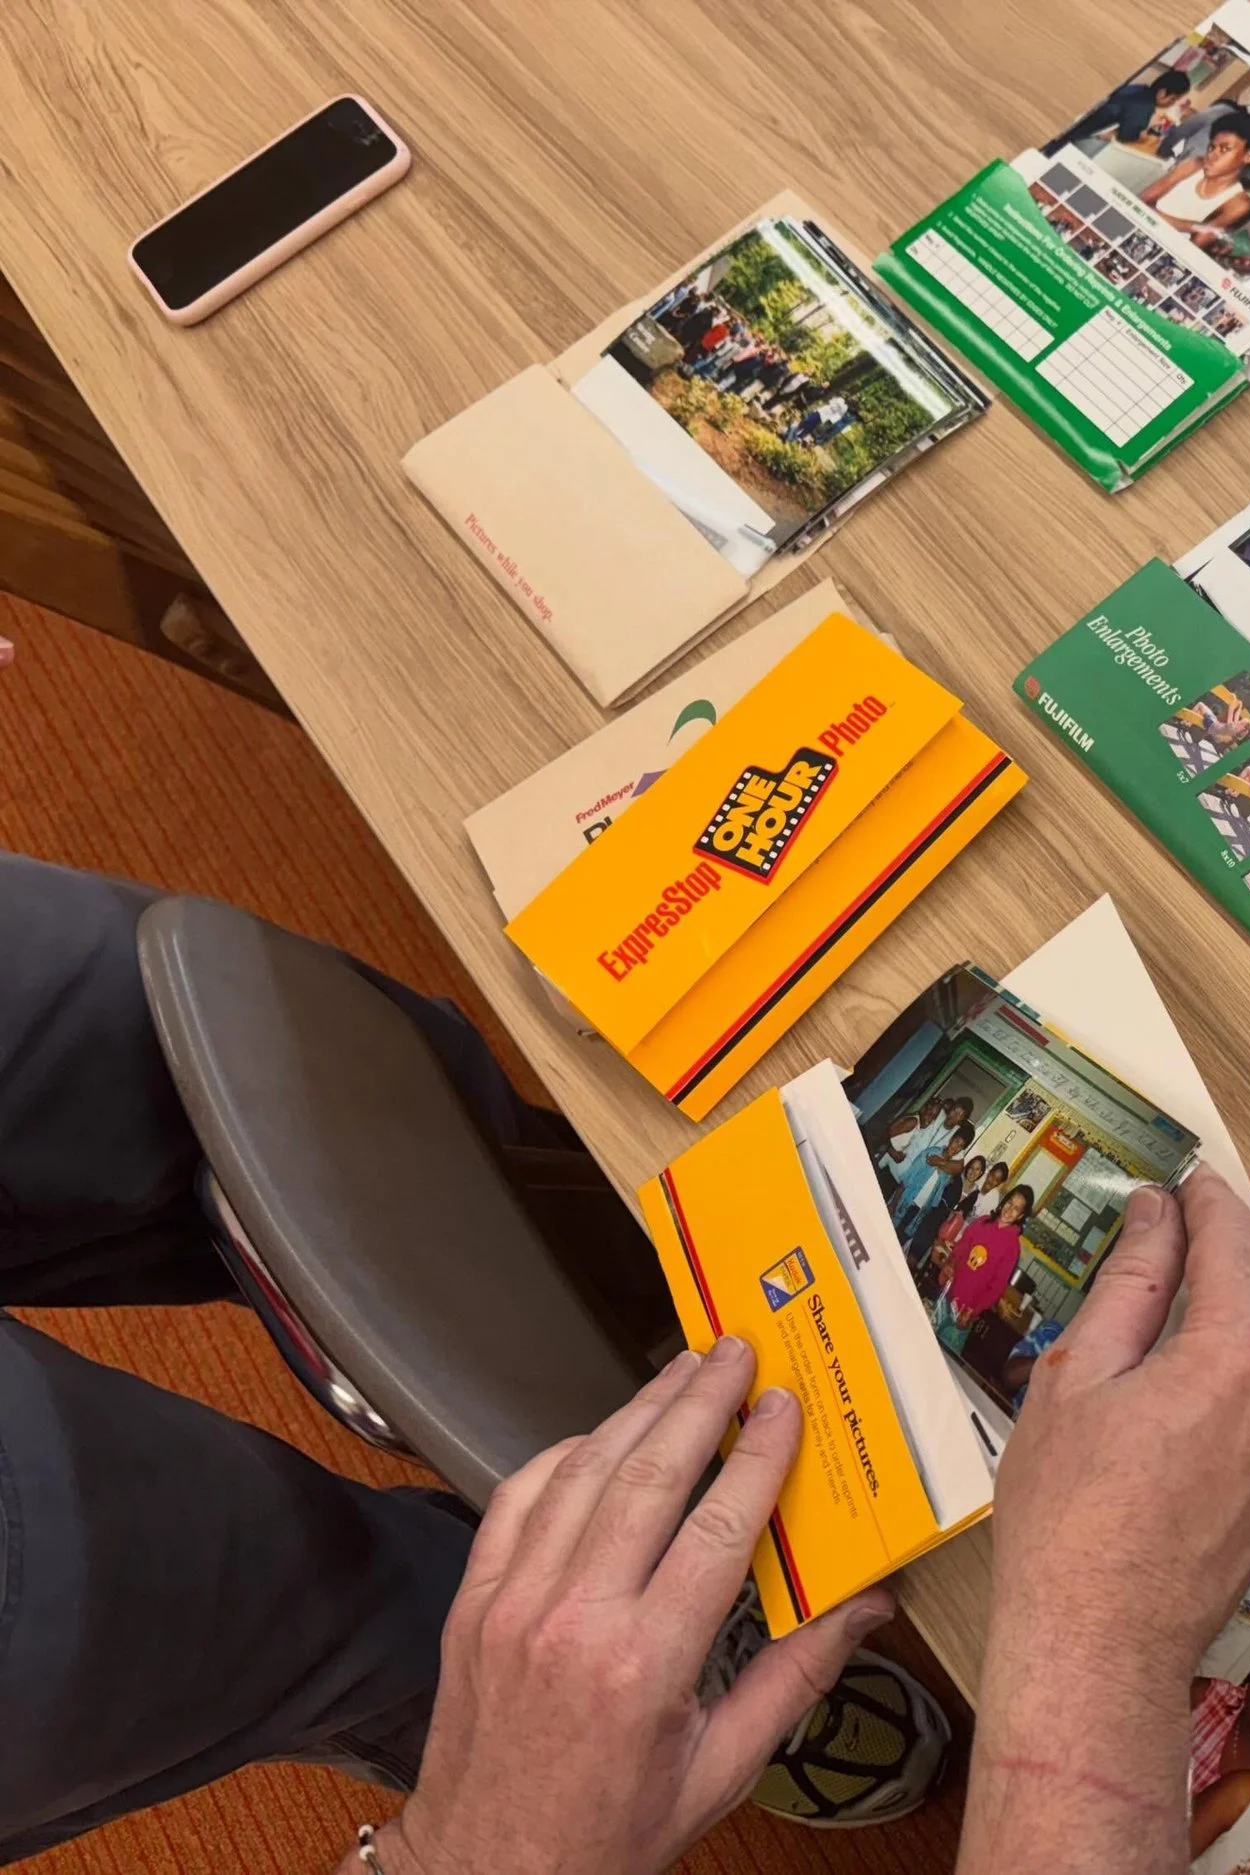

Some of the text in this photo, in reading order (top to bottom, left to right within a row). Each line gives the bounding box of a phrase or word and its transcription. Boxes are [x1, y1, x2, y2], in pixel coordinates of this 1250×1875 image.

[1040, 236, 1056, 252] For
[1053, 247, 1085, 277] Ordering
[1085, 273, 1115, 301] Reprints
[1121, 304, 1171, 350] Enlargements
[465, 514, 552, 622] Pictures while you shop.
[1087, 615, 1181, 705] Enlargements
[1125, 626, 1169, 666] Photo
[1038, 692, 1094, 752] FUJIFILM
[712, 774, 777, 852] ONE
[735, 760, 823, 868] HOUR
[597, 861, 722, 982] ExpresStop
[776, 1320, 789, 1338] and
[784, 1340, 812, 1404] enlargements
[806, 1403, 817, 1418] for
[808, 1294, 878, 1497] Share your pictures.
[784, 1312, 859, 1519] Use the order form on back to order reprints
[806, 1418, 824, 1448] family
[818, 1448, 831, 1468] and
